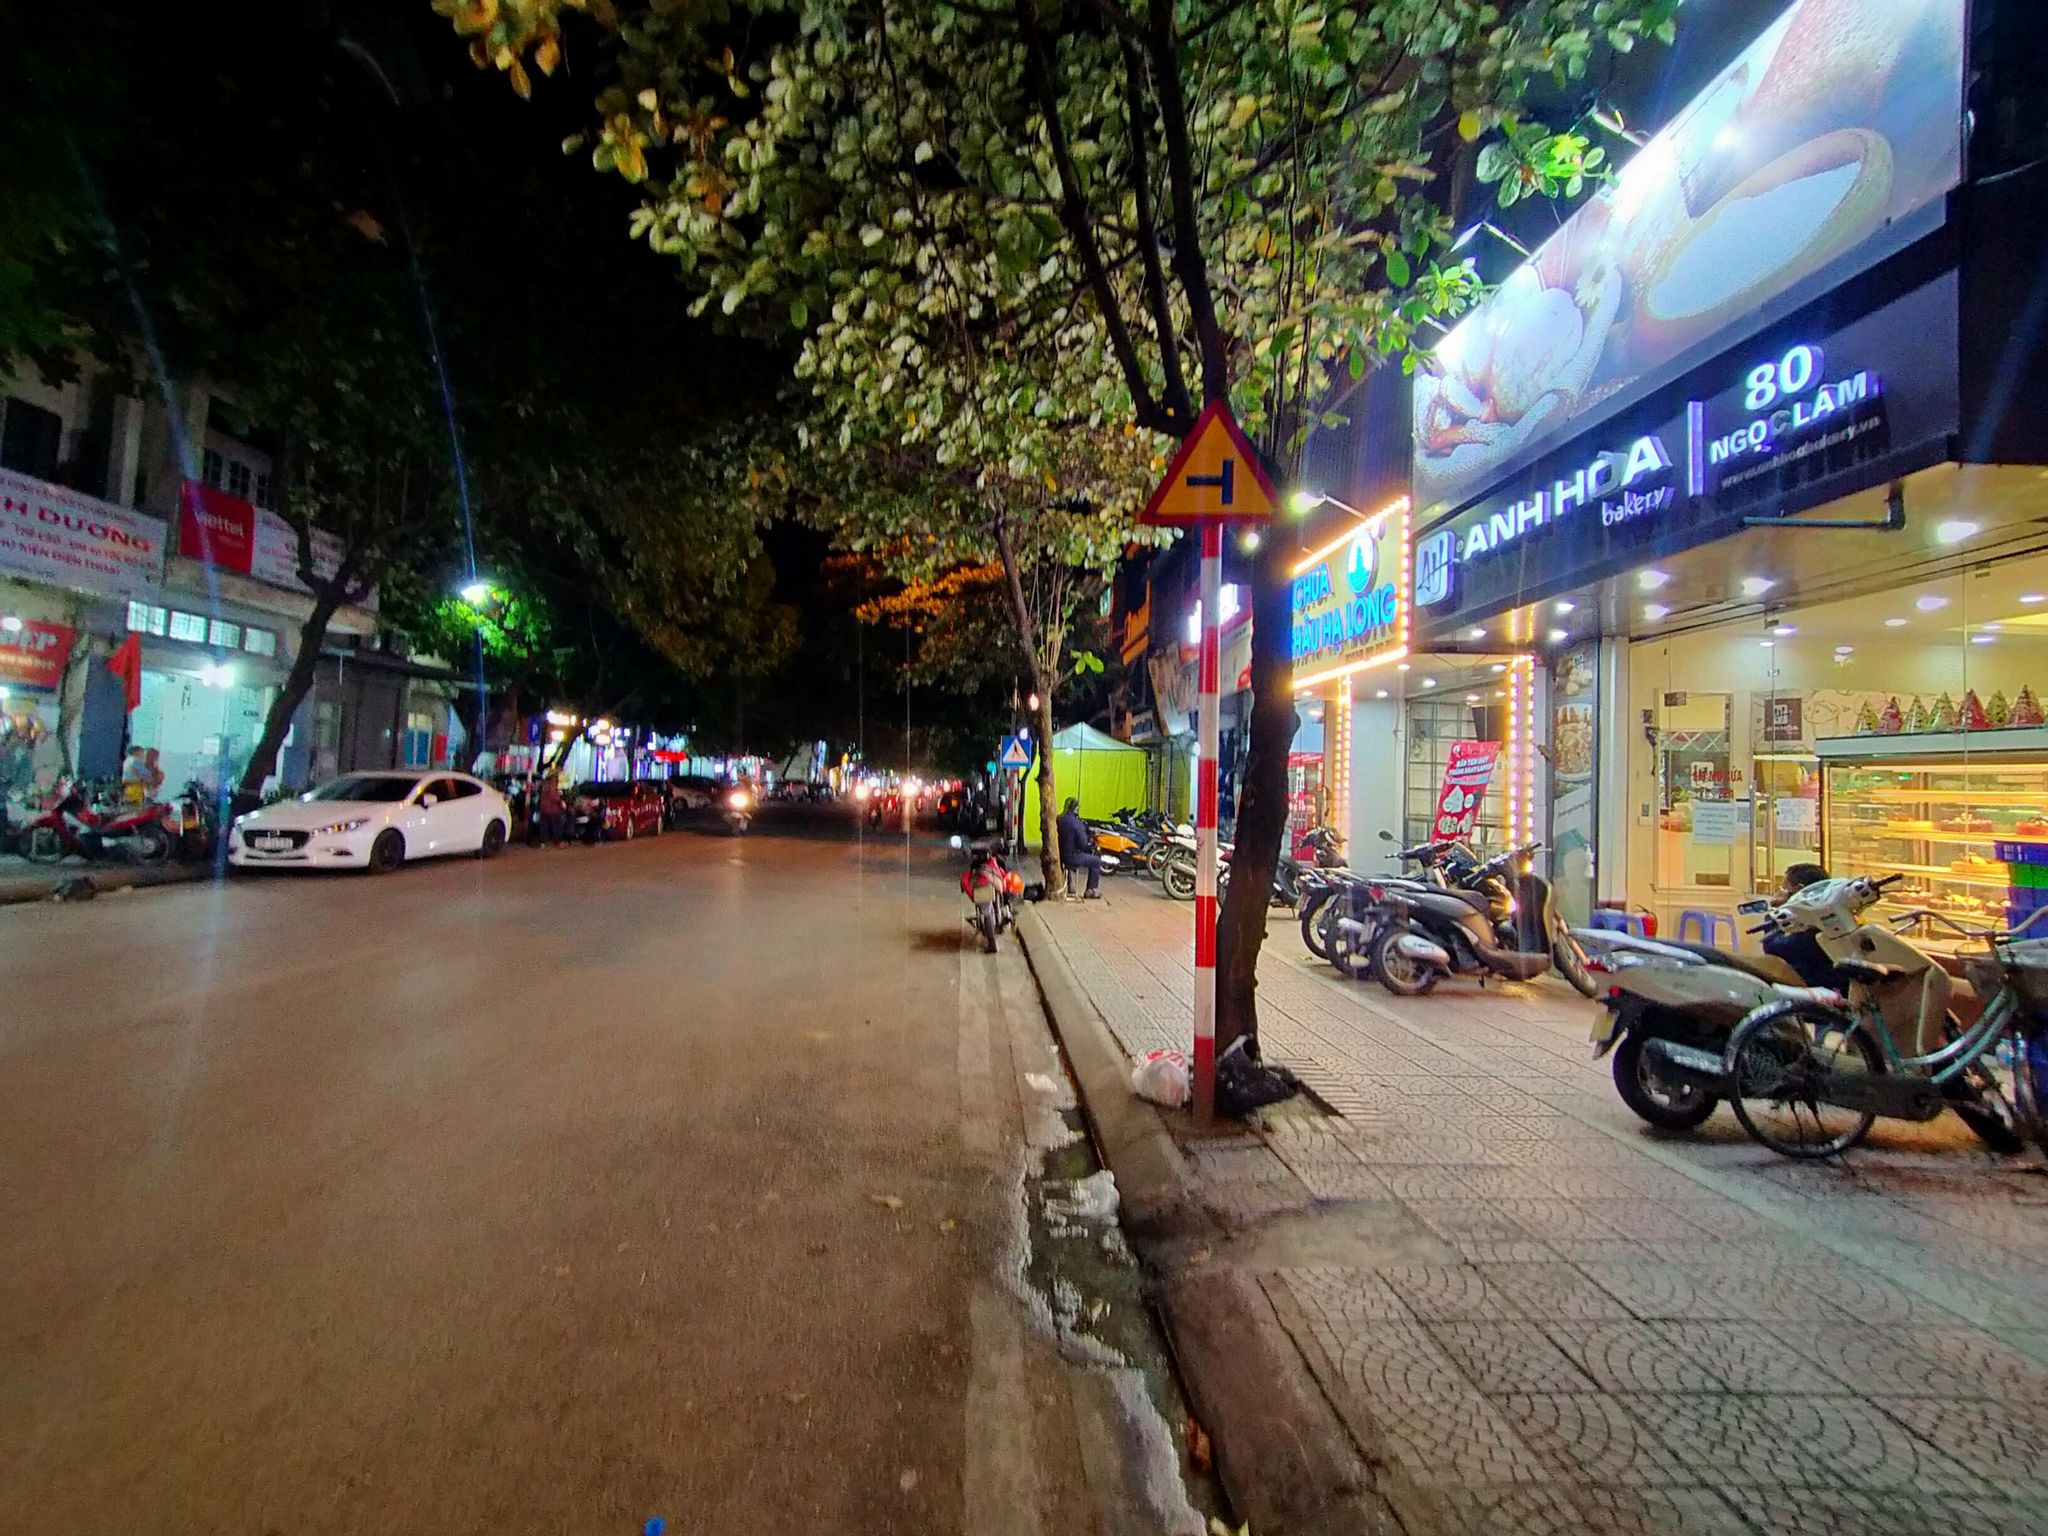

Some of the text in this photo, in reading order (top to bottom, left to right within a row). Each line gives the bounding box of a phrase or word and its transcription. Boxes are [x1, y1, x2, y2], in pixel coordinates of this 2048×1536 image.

[1744, 345, 1816, 411] 80
[1710, 371, 1870, 464] NGỌC LÂM
[1464, 491, 1546, 560] ANH
[1602, 486, 1669, 526] bakery
[1294, 562, 1332, 610] CHUA
[1345, 583, 1397, 638] LONG
